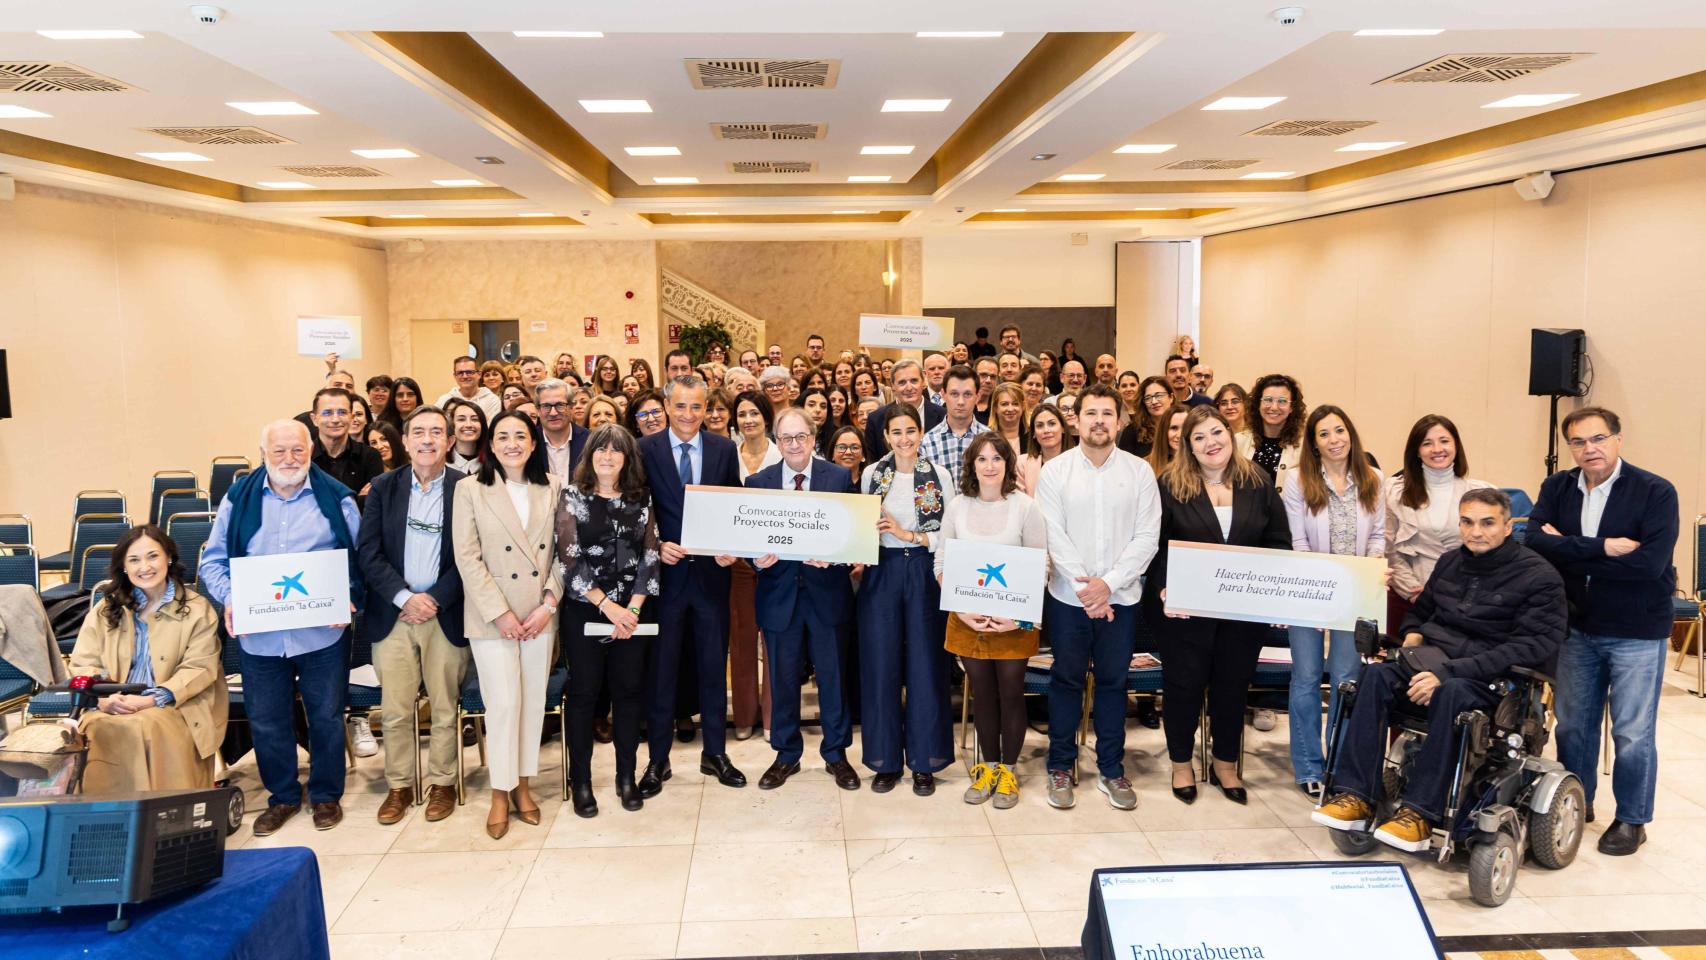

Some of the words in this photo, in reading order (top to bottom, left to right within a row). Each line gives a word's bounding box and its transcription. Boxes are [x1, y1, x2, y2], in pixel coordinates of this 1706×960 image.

[738, 504, 811, 519] Convocatorias
[814, 509, 827, 520] de
[733, 515, 785, 529] Proyectos
[788, 518, 830, 531] Sociales
[767, 535, 793, 545] 2025
[1214, 567, 1257, 582] Hacerlo
[1258, 573, 1338, 589] conjuntamente
[954, 586, 994, 599] Fundación
[1217, 583, 1244, 593] para
[1245, 583, 1286, 597] hacerlo
[1287, 587, 1334, 602] realidad
[248, 603, 295, 615] Fundación
[1129, 942, 1265, 960] Enhorabuena
